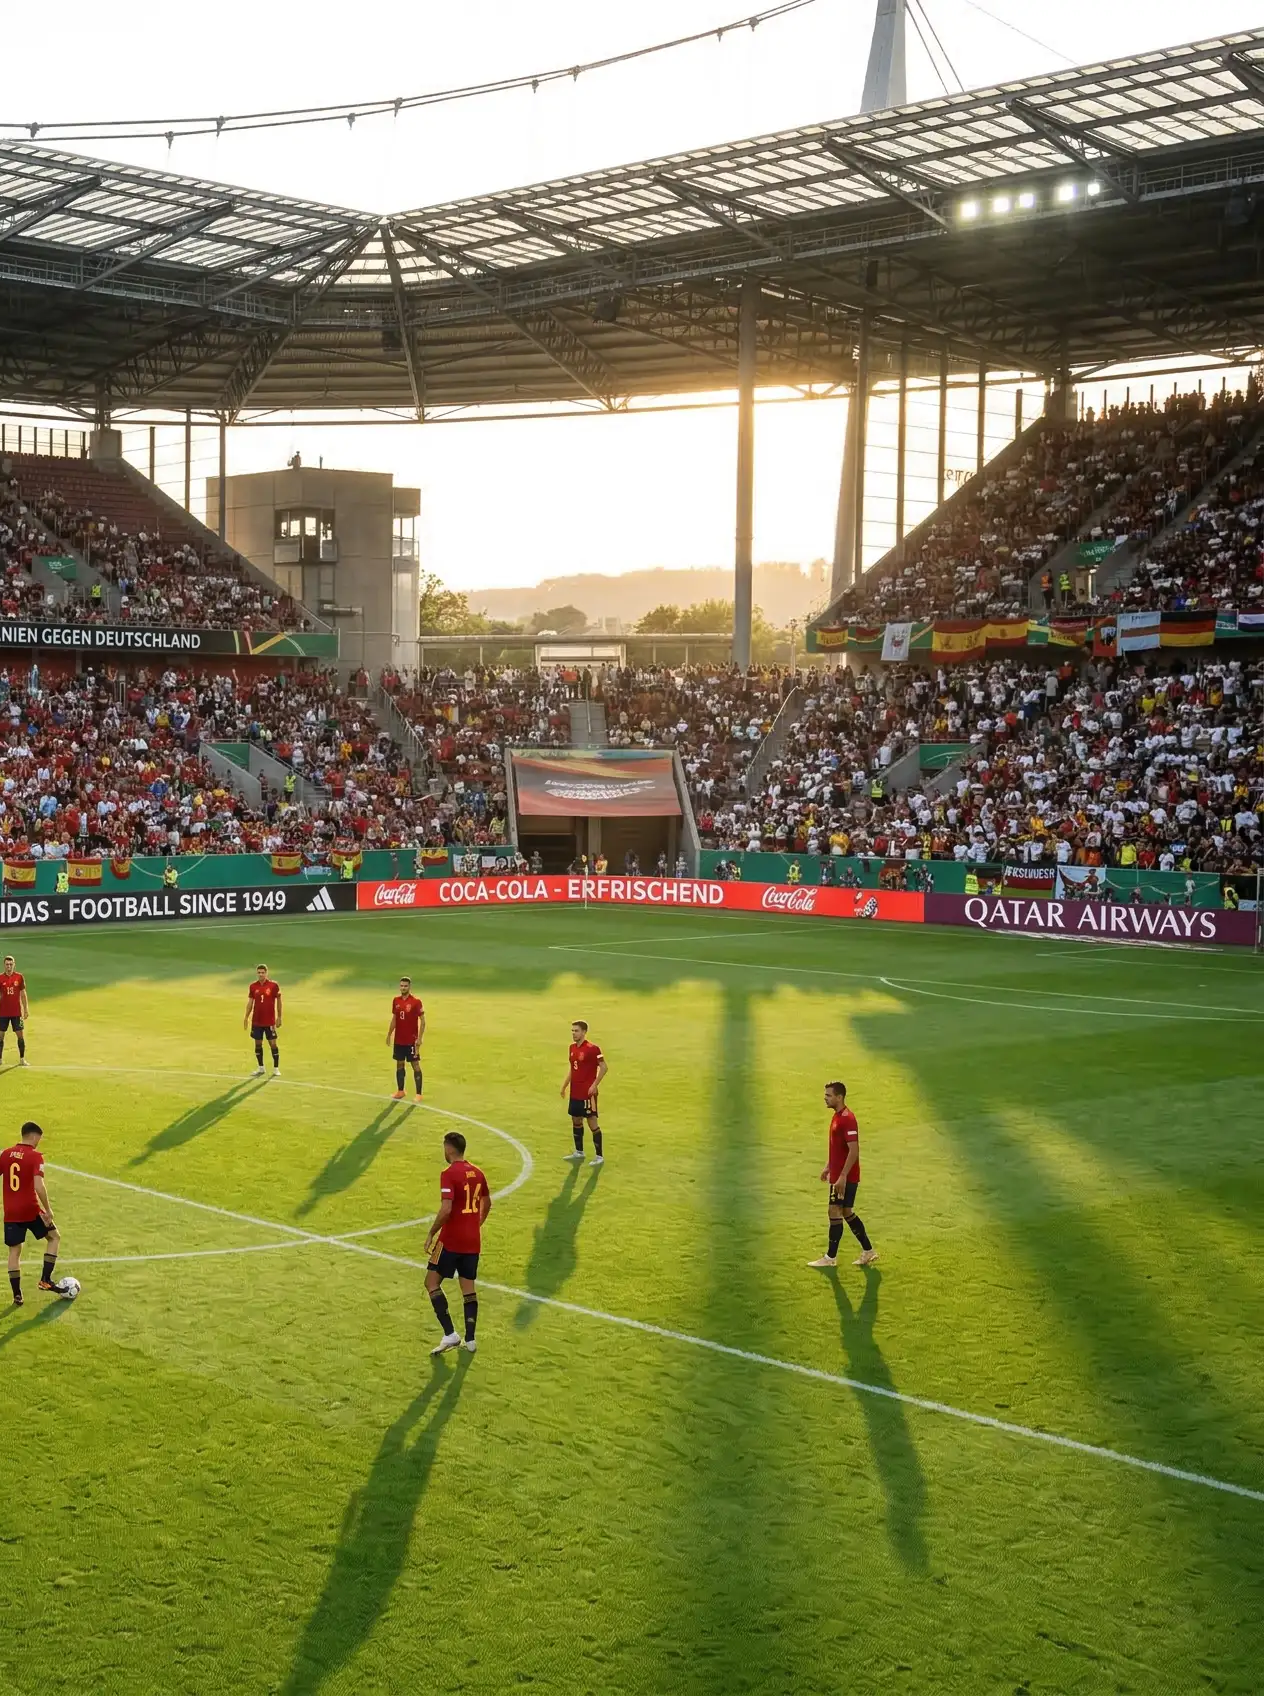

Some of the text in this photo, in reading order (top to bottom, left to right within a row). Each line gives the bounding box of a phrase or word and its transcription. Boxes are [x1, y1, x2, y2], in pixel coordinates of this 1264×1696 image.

[41, 628, 92, 645] GEGEN
[95, 630, 201, 649] DEUTSCHLAND
[69, 896, 175, 920] FOOTBALL
[179, 892, 237, 915] SINCE
[243, 890, 286, 911] 1949
[439, 879, 548, 902] COCA-COLA
[567, 879, 724, 904] ERFRISCHEND
[964, 897, 1216, 938] QATAR AIRWAYS
[9, 1162, 21, 1192] 6
